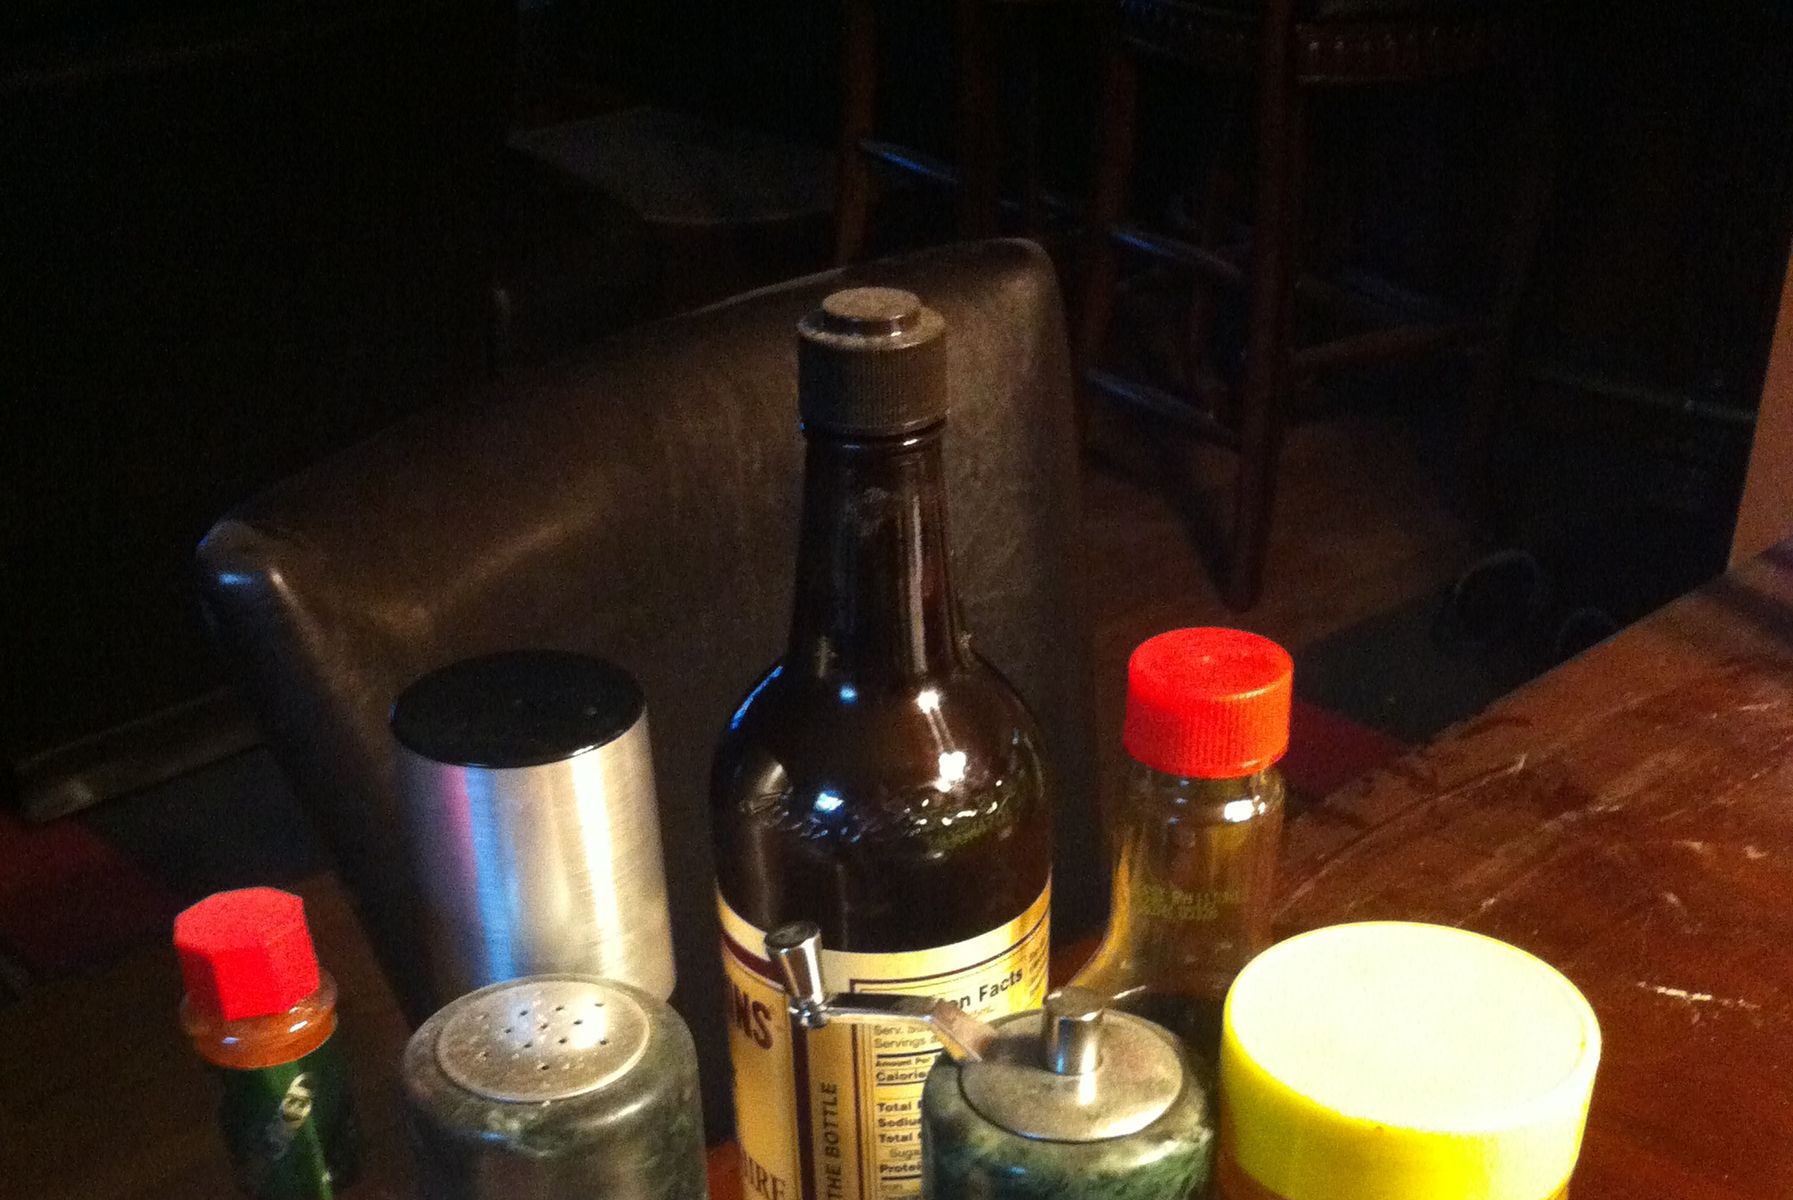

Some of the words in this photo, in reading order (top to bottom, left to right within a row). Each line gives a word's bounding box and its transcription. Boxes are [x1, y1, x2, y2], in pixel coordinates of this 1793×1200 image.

[978, 967, 1023, 1002] Facts
[877, 1101, 912, 1113] Total
[820, 1082, 841, 1161] BOTTLE
[878, 1116, 922, 1128] Sodiu
[879, 1132, 914, 1144] Total
